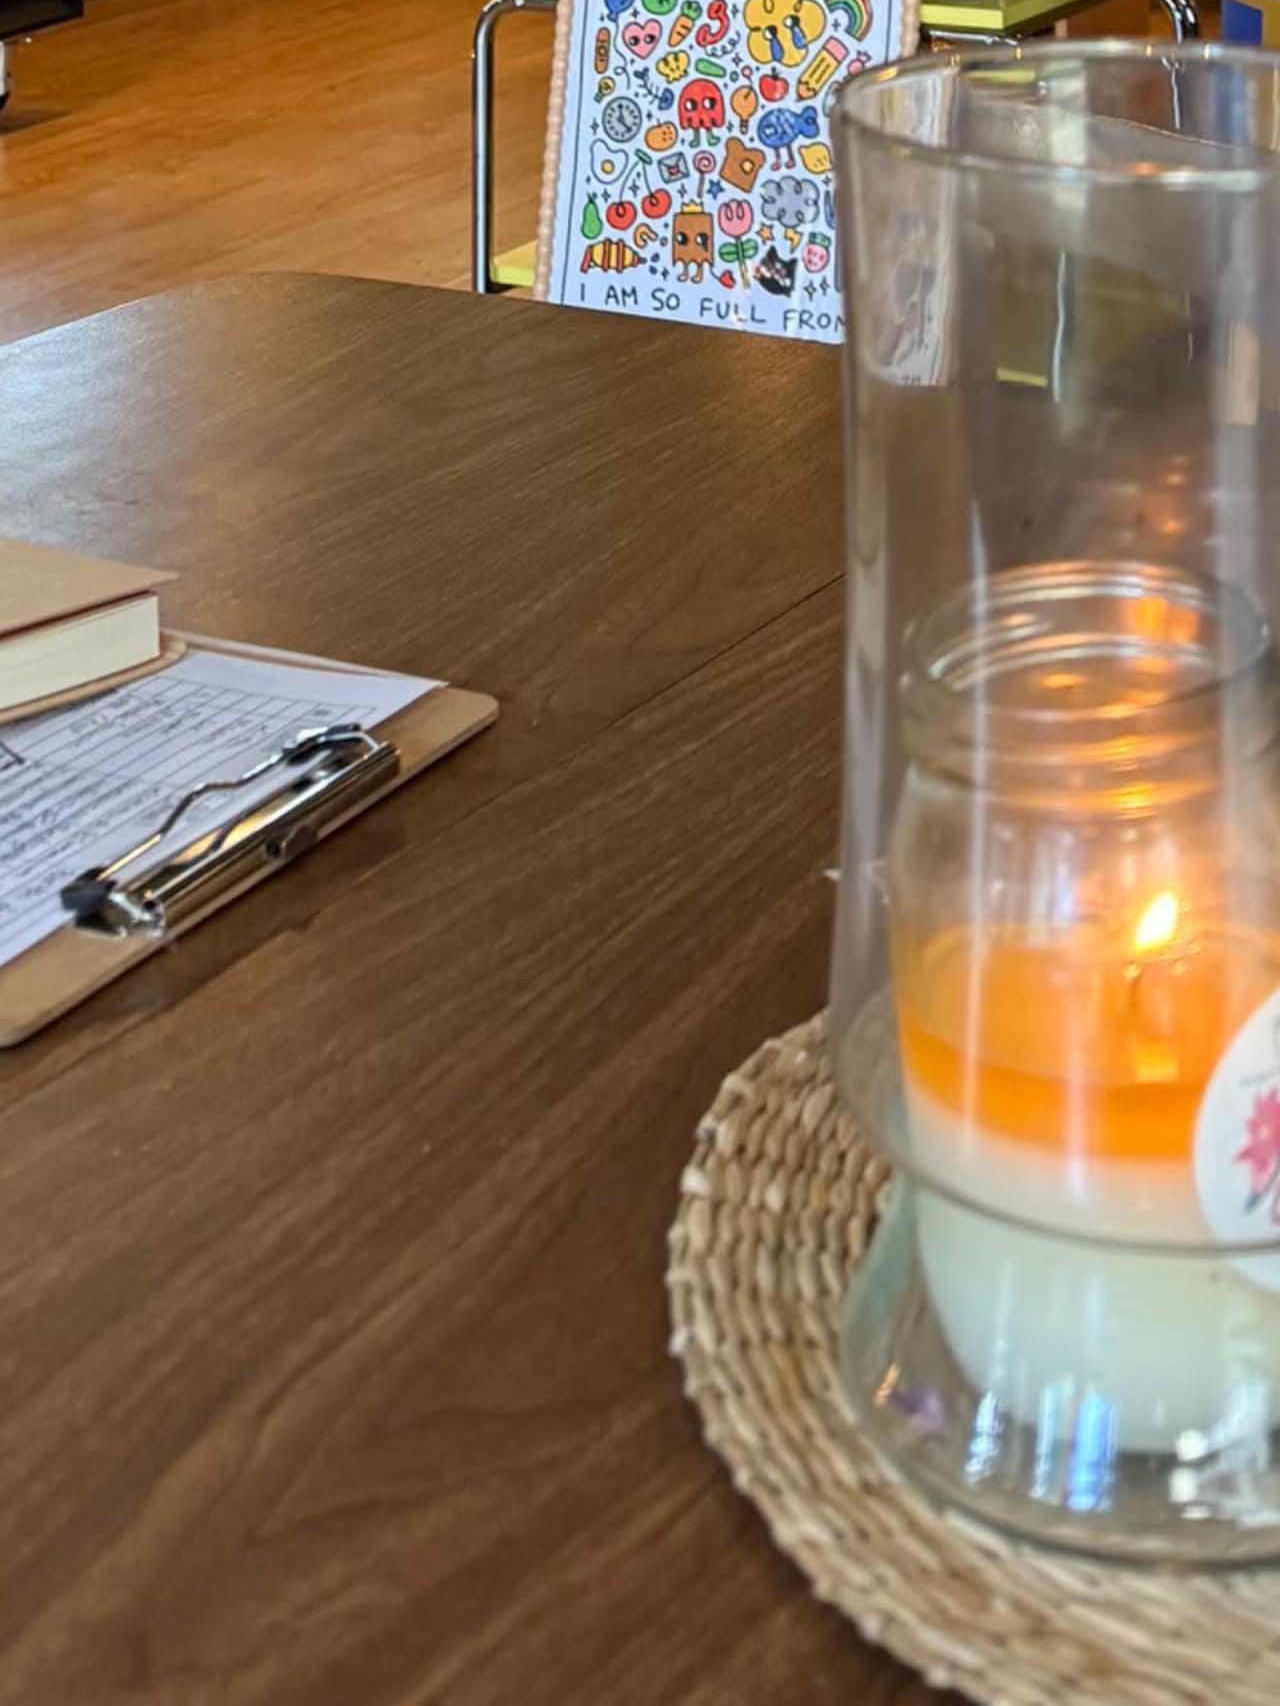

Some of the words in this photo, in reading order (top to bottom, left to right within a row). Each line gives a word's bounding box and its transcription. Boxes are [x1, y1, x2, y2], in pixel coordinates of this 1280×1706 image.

[580, 283, 586, 302] I
[605, 287, 639, 306] AM
[650, 289, 681, 311] SO
[700, 298, 767, 325] FULL
